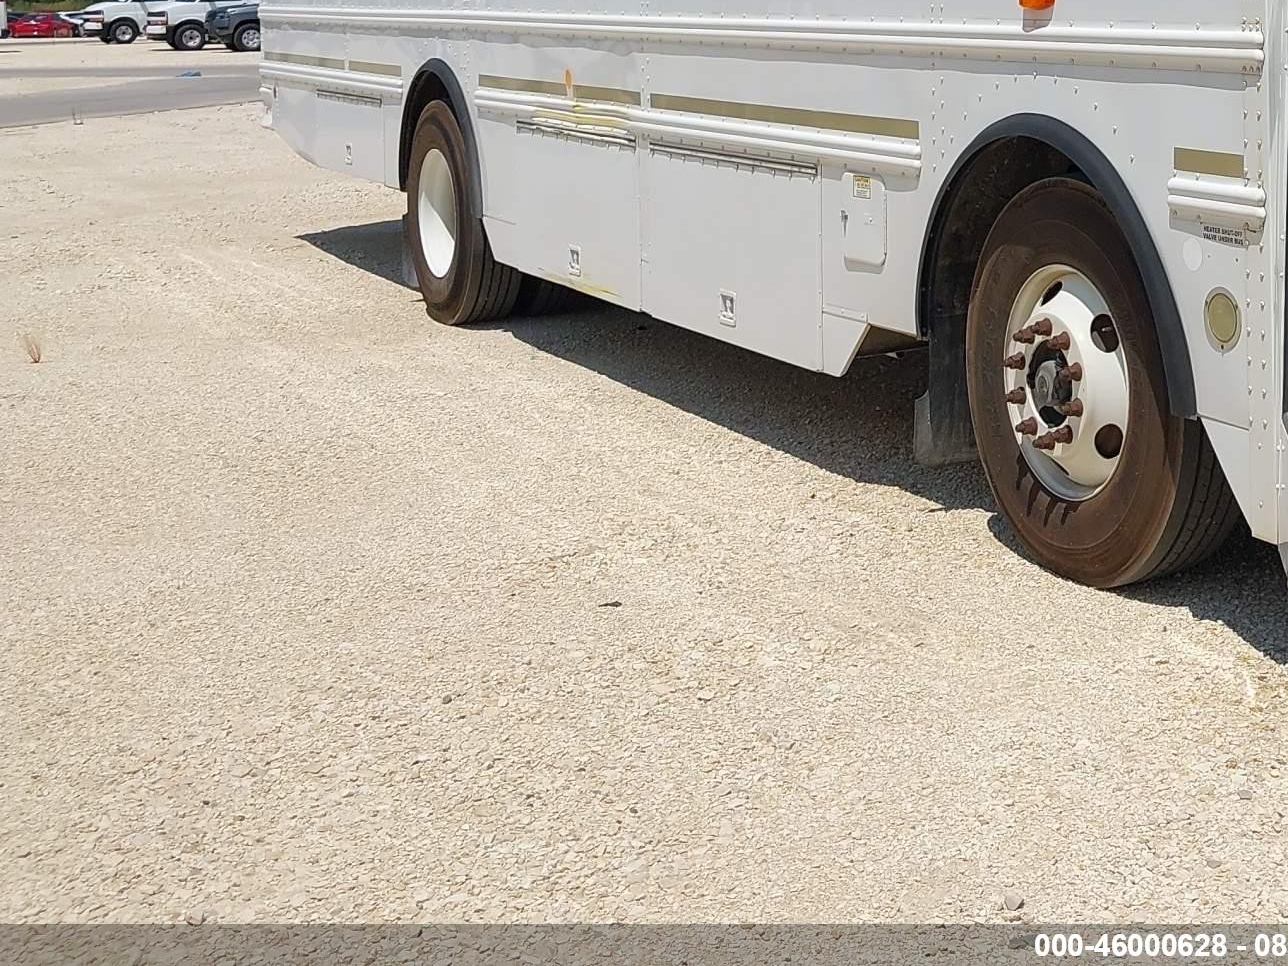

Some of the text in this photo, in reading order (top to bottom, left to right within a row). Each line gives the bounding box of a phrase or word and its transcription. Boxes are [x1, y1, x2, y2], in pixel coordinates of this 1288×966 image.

[1203, 225, 1243, 238] HEATER SHUT-OFF
[1203, 232, 1244, 246] VALVE UNDER BUS
